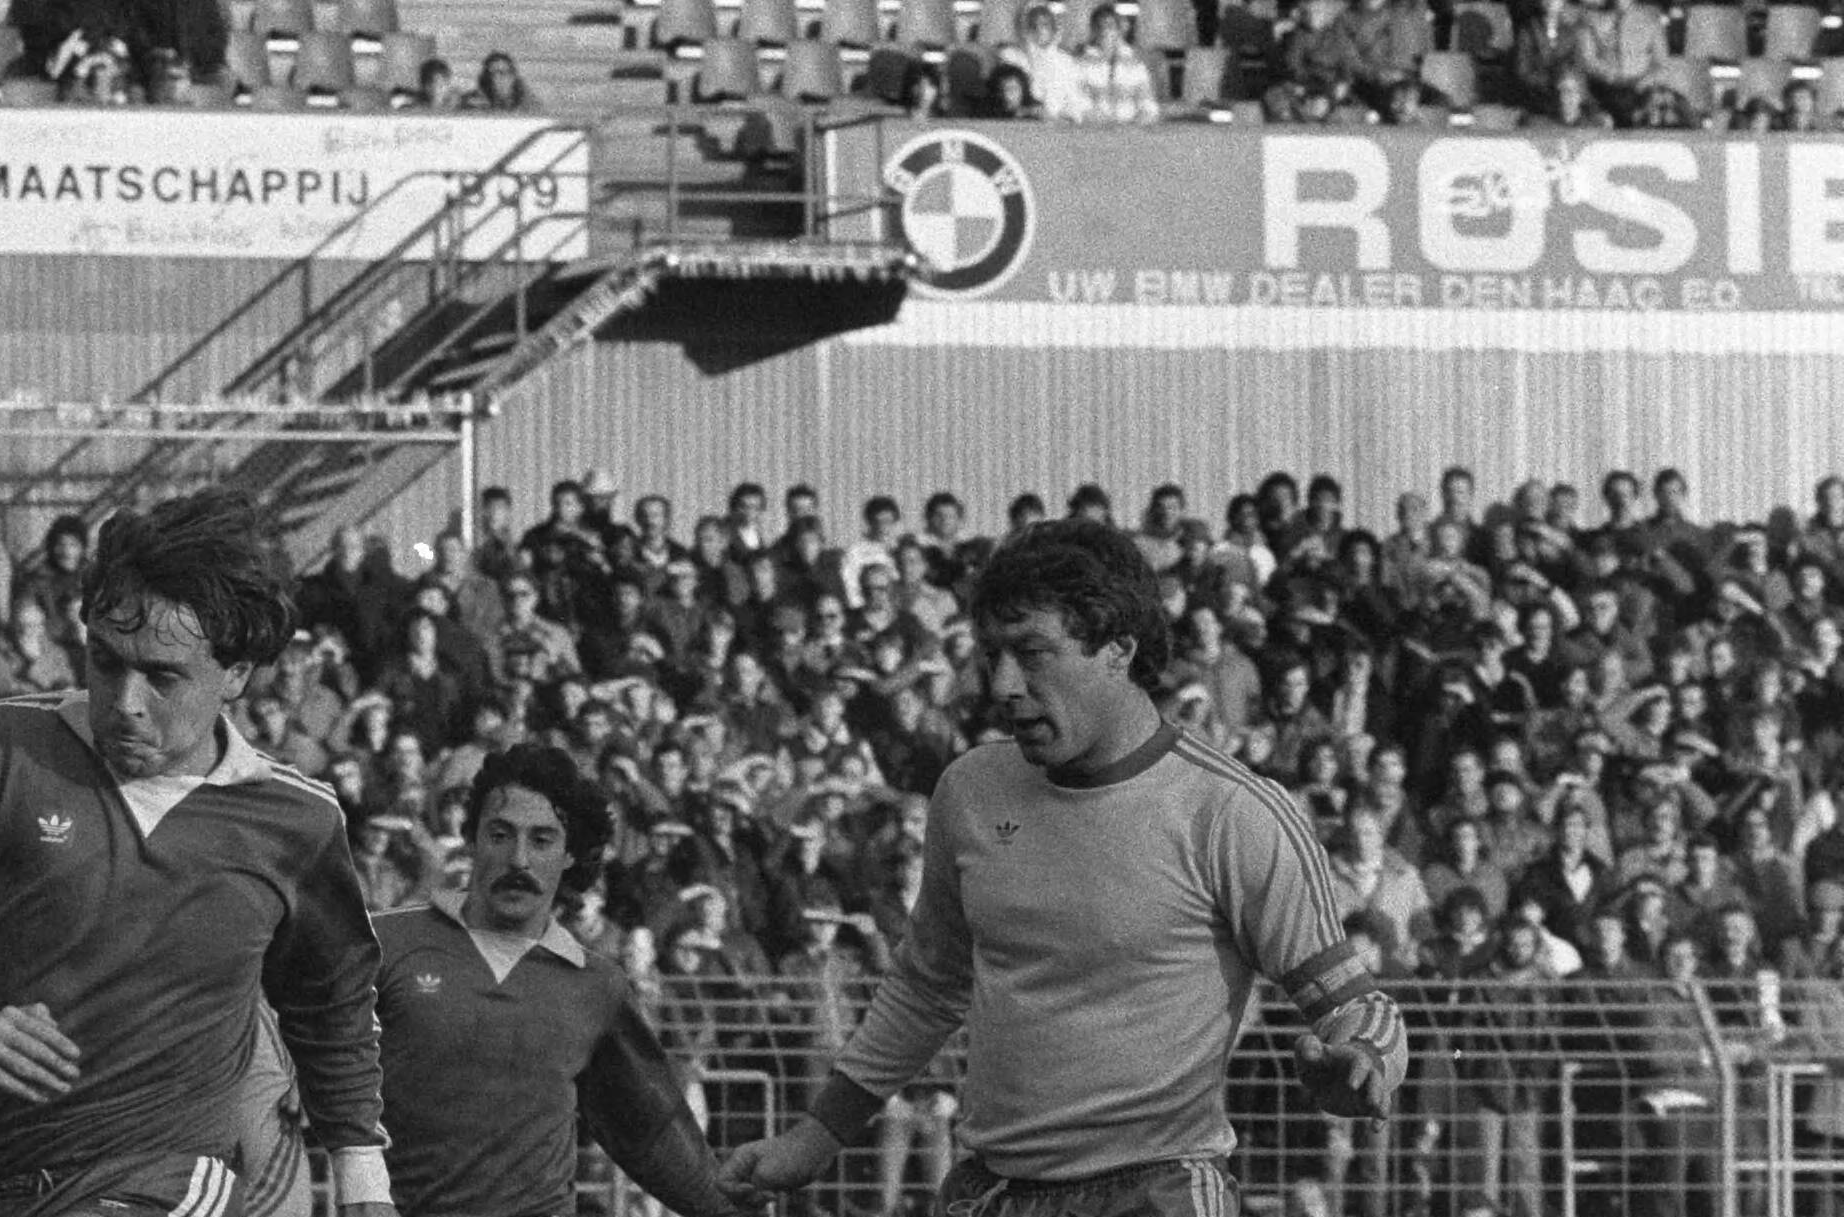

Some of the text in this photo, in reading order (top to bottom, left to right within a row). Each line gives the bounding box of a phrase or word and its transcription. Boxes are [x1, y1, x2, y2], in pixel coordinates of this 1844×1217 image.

[1047, 269, 1116, 301] UW
[1134, 269, 1234, 303] BMW
[1249, 272, 1422, 304] DEALER
[1441, 275, 1532, 306] DEN
